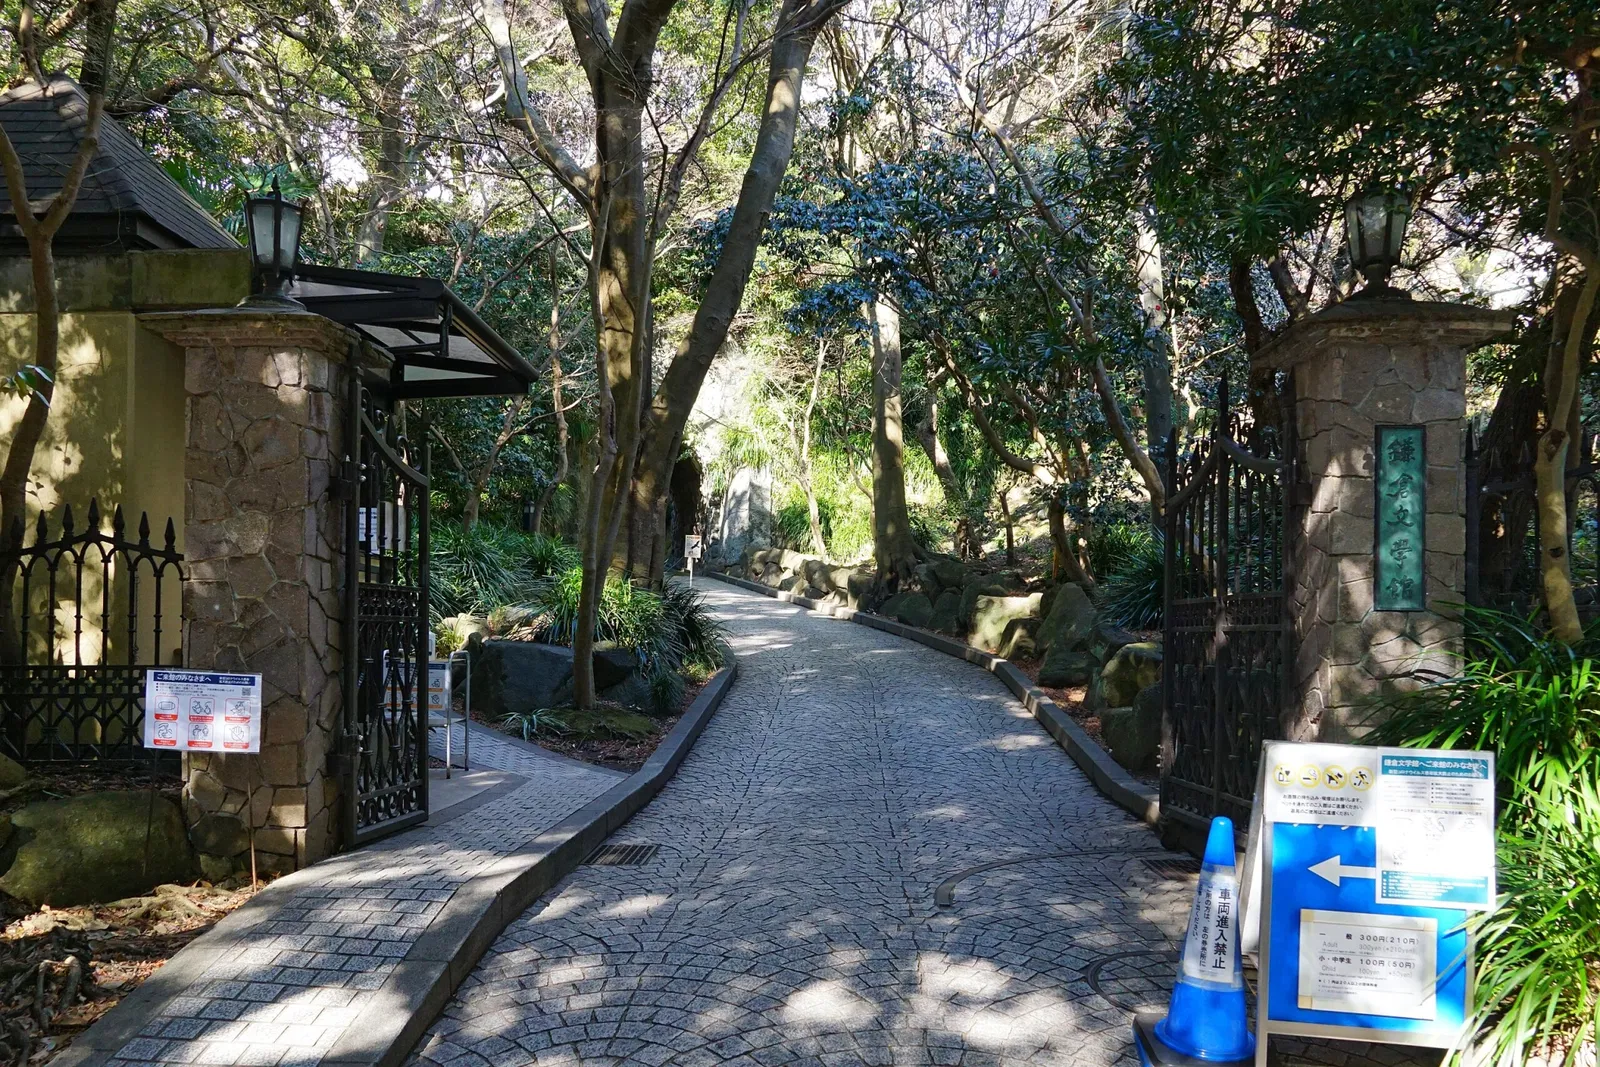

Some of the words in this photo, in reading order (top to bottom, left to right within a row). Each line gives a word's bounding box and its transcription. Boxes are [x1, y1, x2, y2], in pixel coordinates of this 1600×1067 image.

[156, 673, 212, 683] ご来館のみなさまへ
[1212, 888, 1231, 970] 車両進入禁止
[1322, 941, 1338, 949] Adult
[1321, 964, 1337, 972] Child
